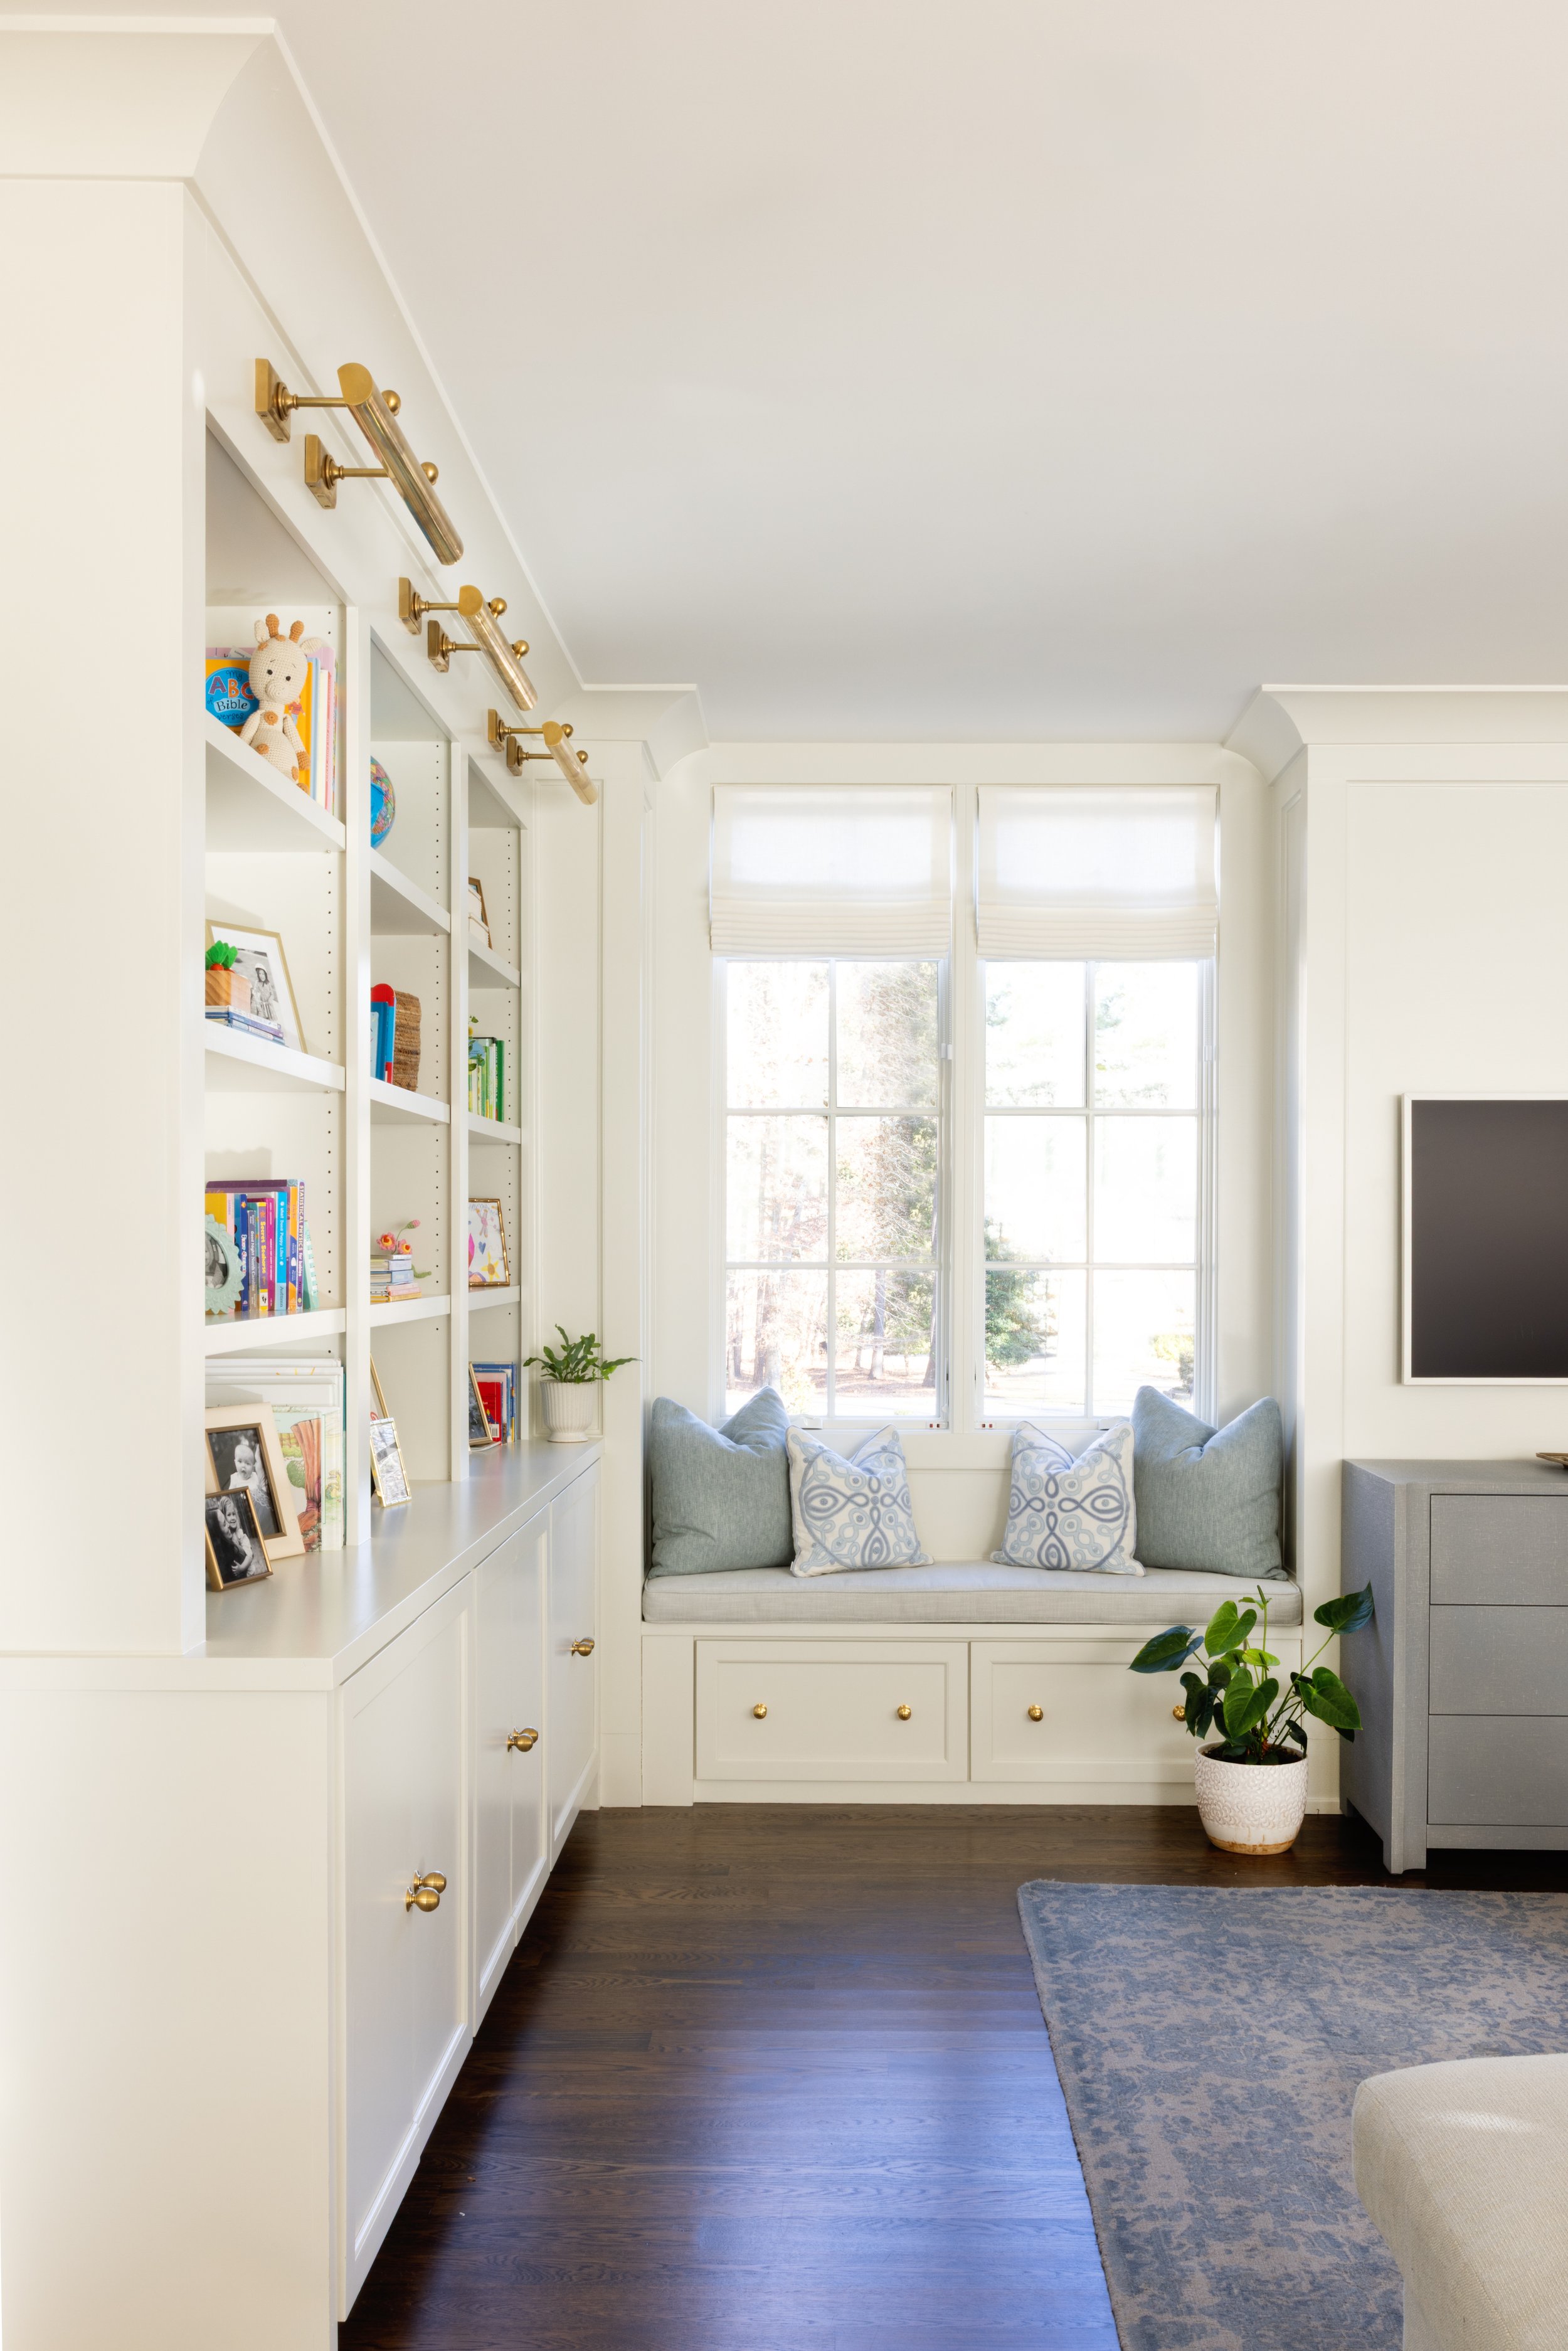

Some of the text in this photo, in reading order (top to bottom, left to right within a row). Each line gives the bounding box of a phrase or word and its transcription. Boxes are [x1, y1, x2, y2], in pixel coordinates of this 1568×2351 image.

[226, 670, 243, 681] My
[208, 676, 254, 700] ABC
[216, 699, 248, 711] Bible
[217, 712, 244, 720] verses
